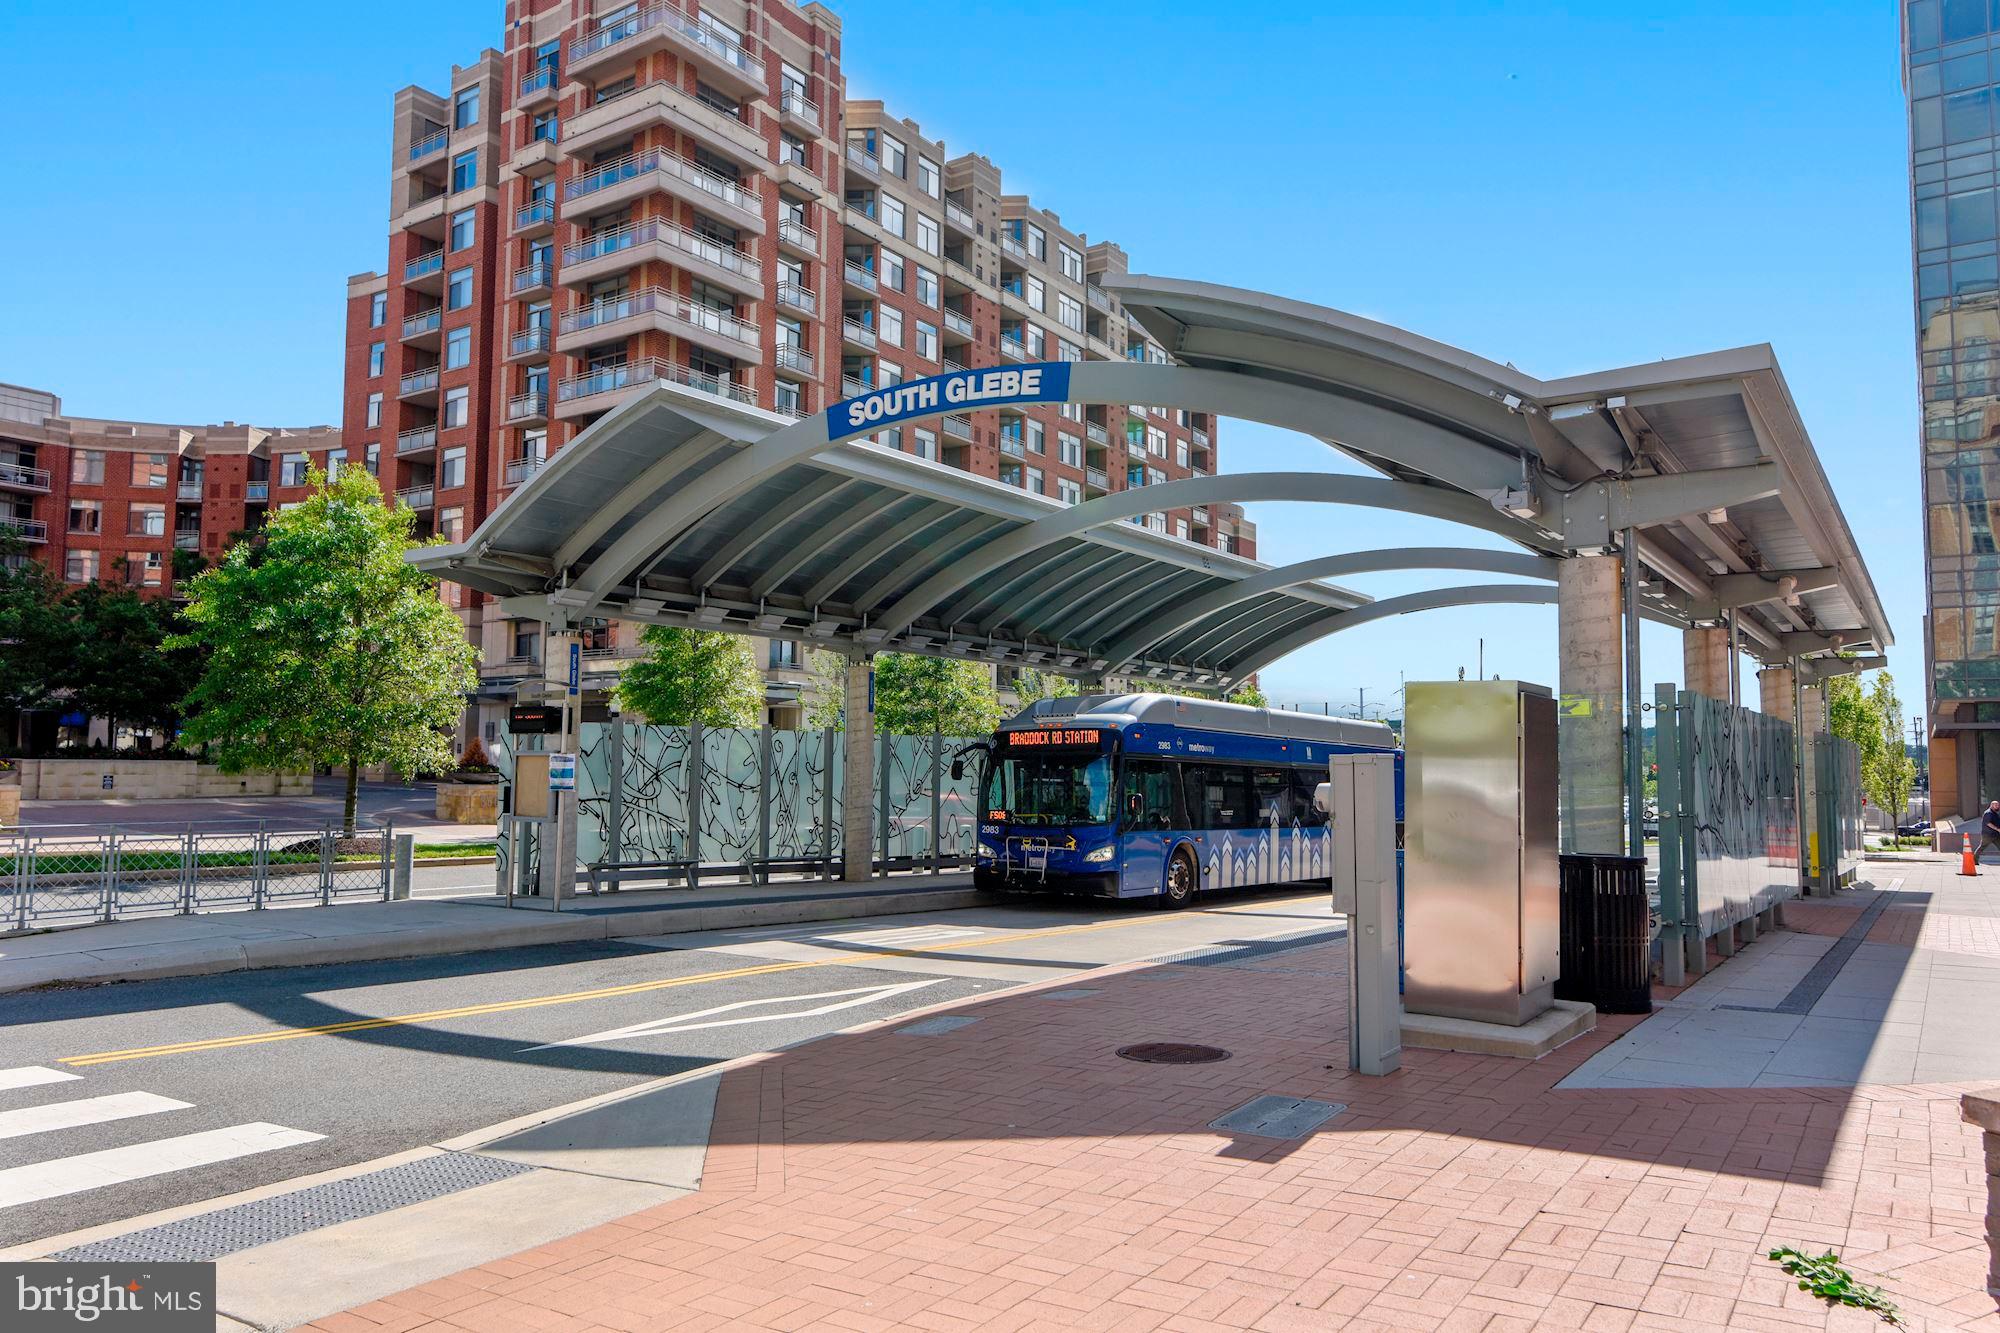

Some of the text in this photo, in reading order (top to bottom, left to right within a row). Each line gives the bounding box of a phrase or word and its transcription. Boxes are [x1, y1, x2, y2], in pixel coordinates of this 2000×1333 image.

[848, 369, 1042, 427] SOUTH GLEBE
[1009, 730, 1099, 745] BRADDOCK RD STATION
[1158, 741, 1171, 750] 2983
[1188, 743, 1215, 755] metroway
[981, 825, 1000, 834] 2983
